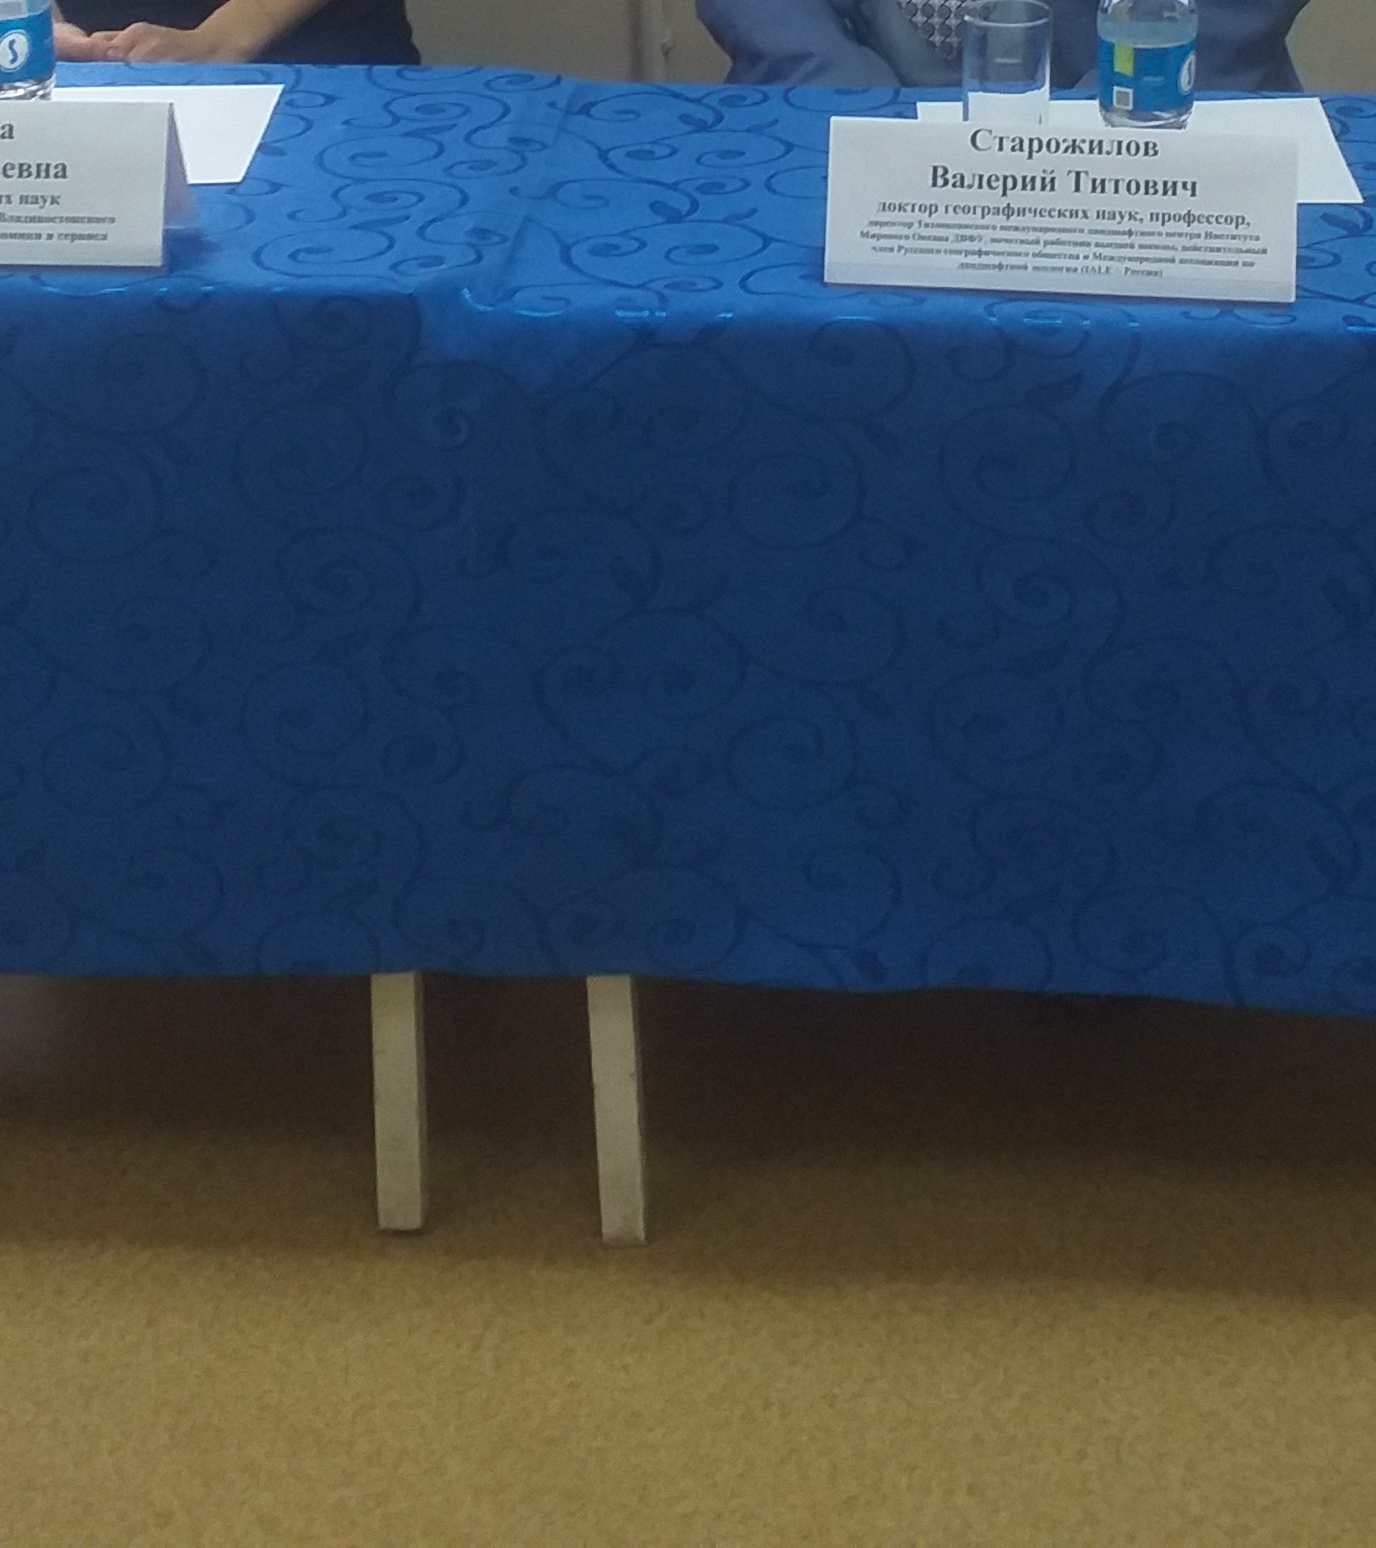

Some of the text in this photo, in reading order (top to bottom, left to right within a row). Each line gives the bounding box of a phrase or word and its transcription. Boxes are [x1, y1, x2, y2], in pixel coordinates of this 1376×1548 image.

[969, 127, 1160, 160] Старожилов
[930, 164, 1200, 199] Валерий Титович
[18, 194, 62, 210] наук
[877, 202, 1252, 230] доктор географических наук, профессор,
